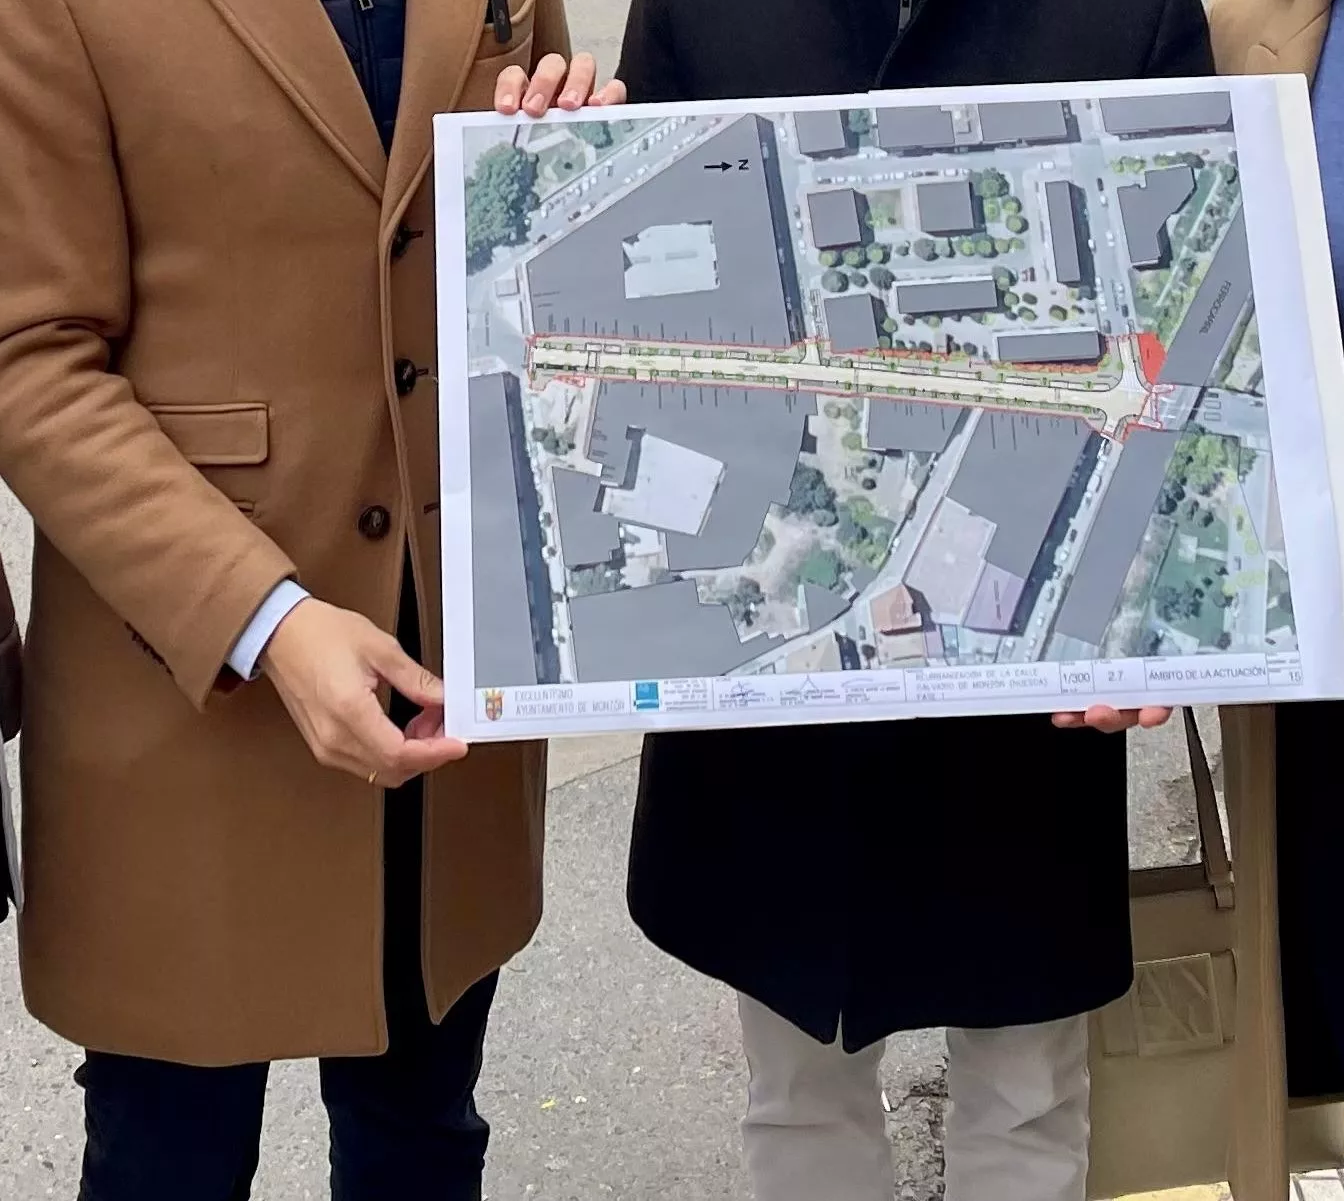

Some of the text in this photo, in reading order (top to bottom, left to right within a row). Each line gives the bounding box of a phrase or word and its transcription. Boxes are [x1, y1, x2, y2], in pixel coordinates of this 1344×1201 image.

[1063, 671, 1091, 684] 1/300
[1186, 670, 1198, 680] DE
[1200, 669, 1212, 679] LA
[1213, 666, 1266, 678] ACTUACIÓN
